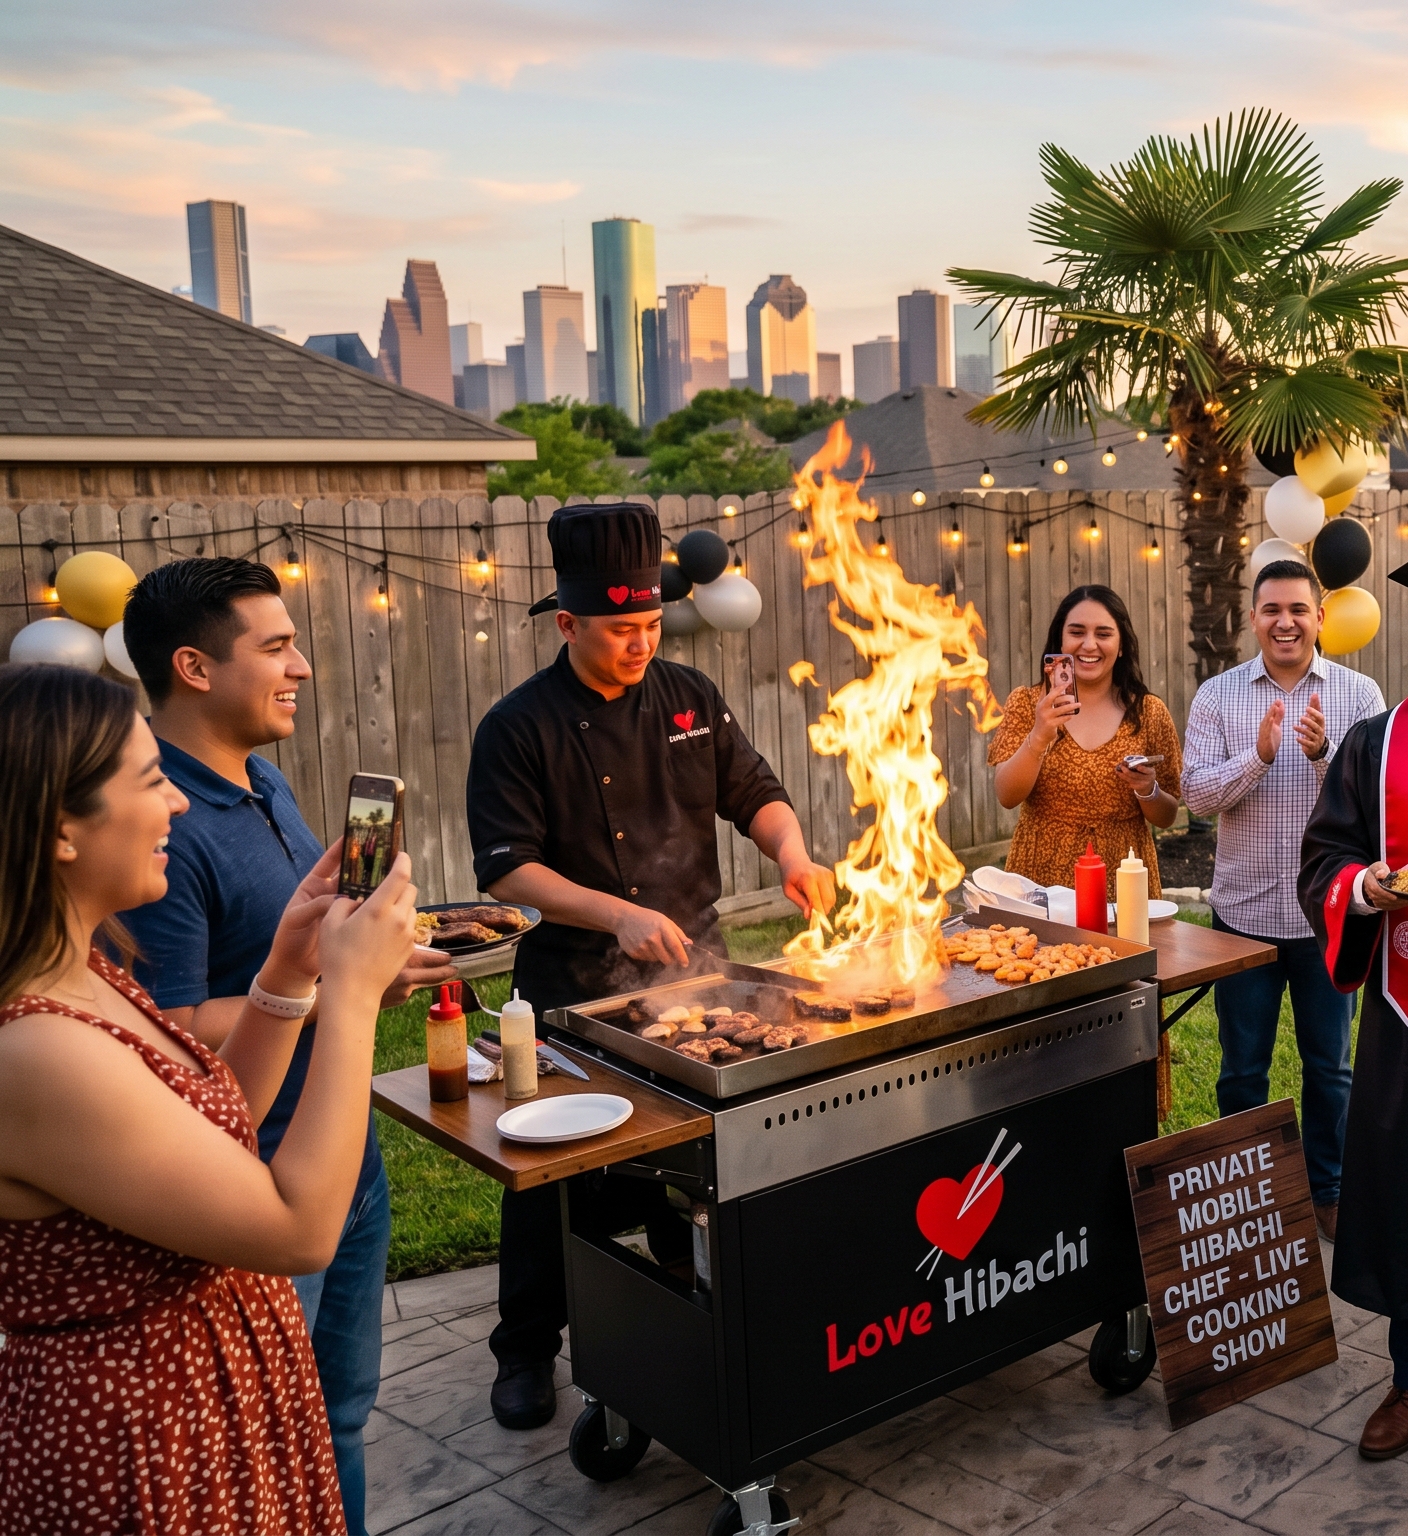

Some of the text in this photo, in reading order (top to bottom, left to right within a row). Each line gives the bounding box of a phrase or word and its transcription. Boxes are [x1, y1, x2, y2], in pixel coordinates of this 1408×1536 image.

[1168, 1141, 1275, 1201] PRIVATE
[1177, 1177, 1275, 1235] MOBILE
[1179, 1210, 1284, 1272] HIBACHI
[825, 1226, 1089, 1373] Love Hibachi
[1164, 1266, 1231, 1314] CHEF
[1254, 1237, 1309, 1281] LIVE
[1186, 1277, 1301, 1344] COOKING
[1212, 1317, 1286, 1372] SHOW
